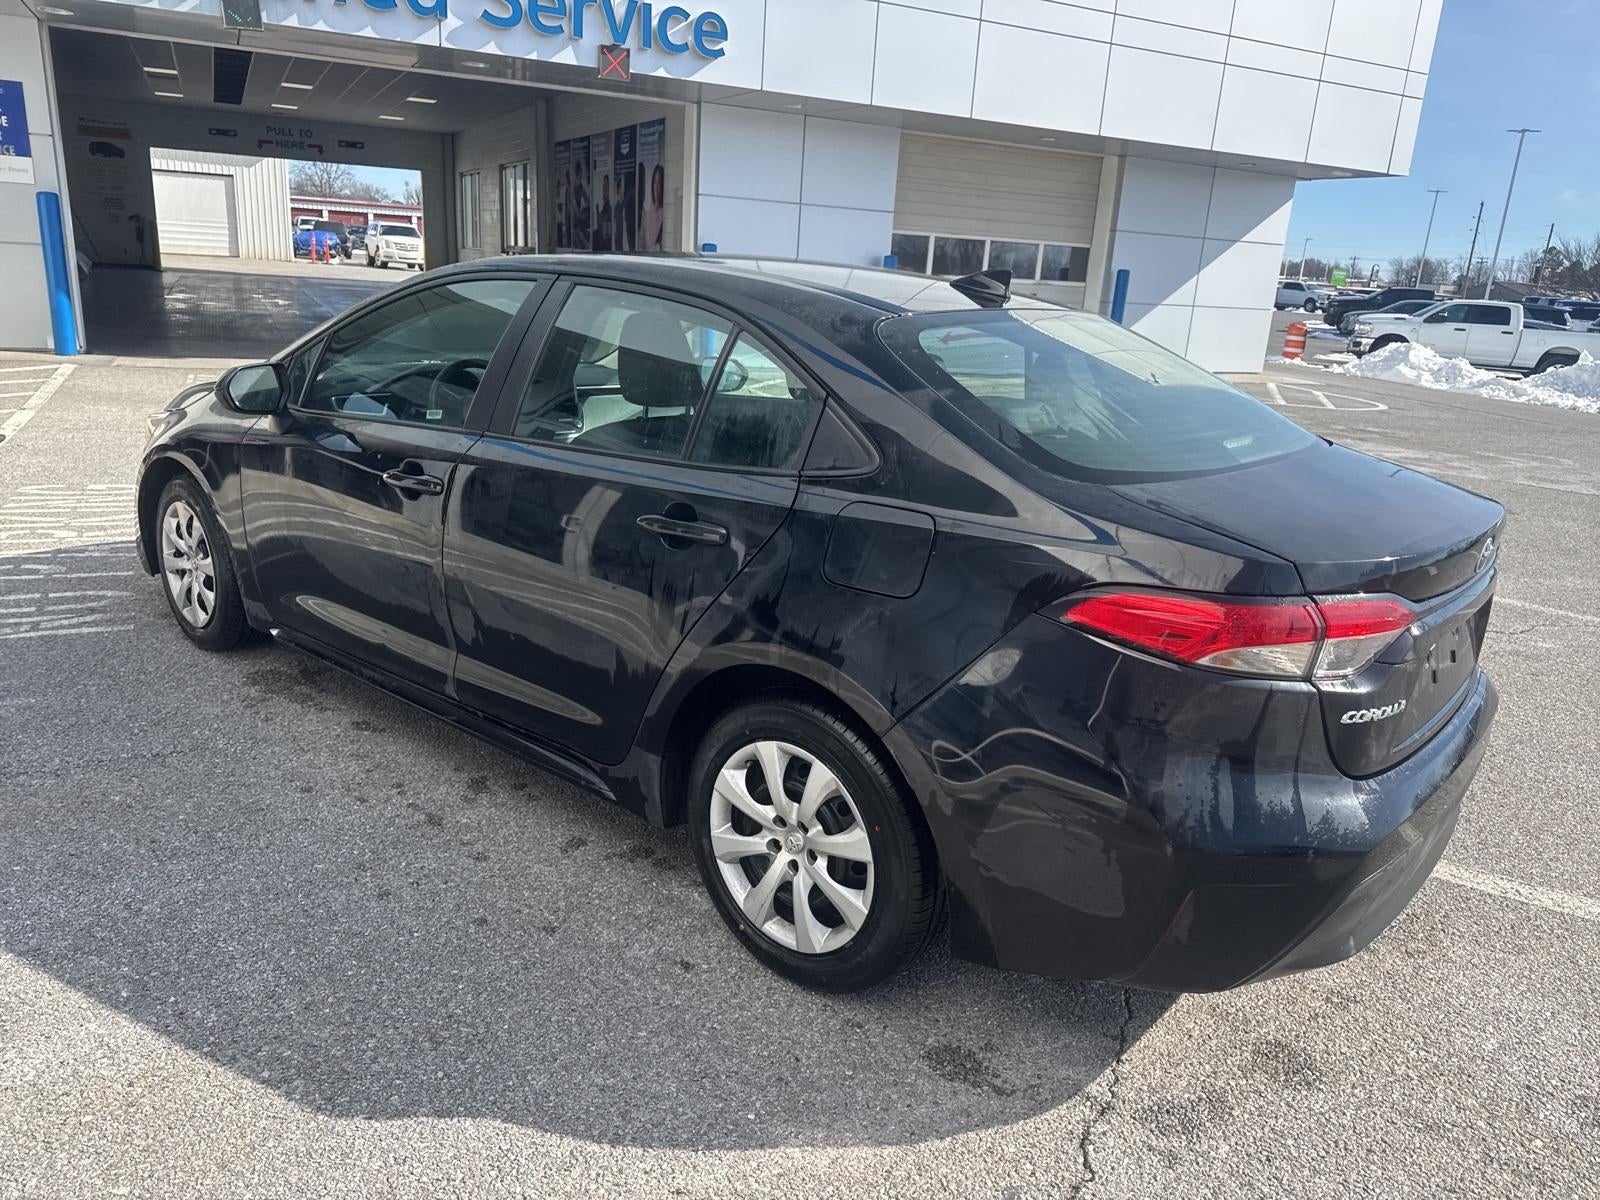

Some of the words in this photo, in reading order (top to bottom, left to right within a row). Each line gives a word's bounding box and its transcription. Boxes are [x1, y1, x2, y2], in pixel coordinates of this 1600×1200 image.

[265, 126, 295, 137] PULL
[298, 128, 313, 138] TO
[275, 139, 306, 150] HERE
[1339, 699, 1407, 724] COROLLA
